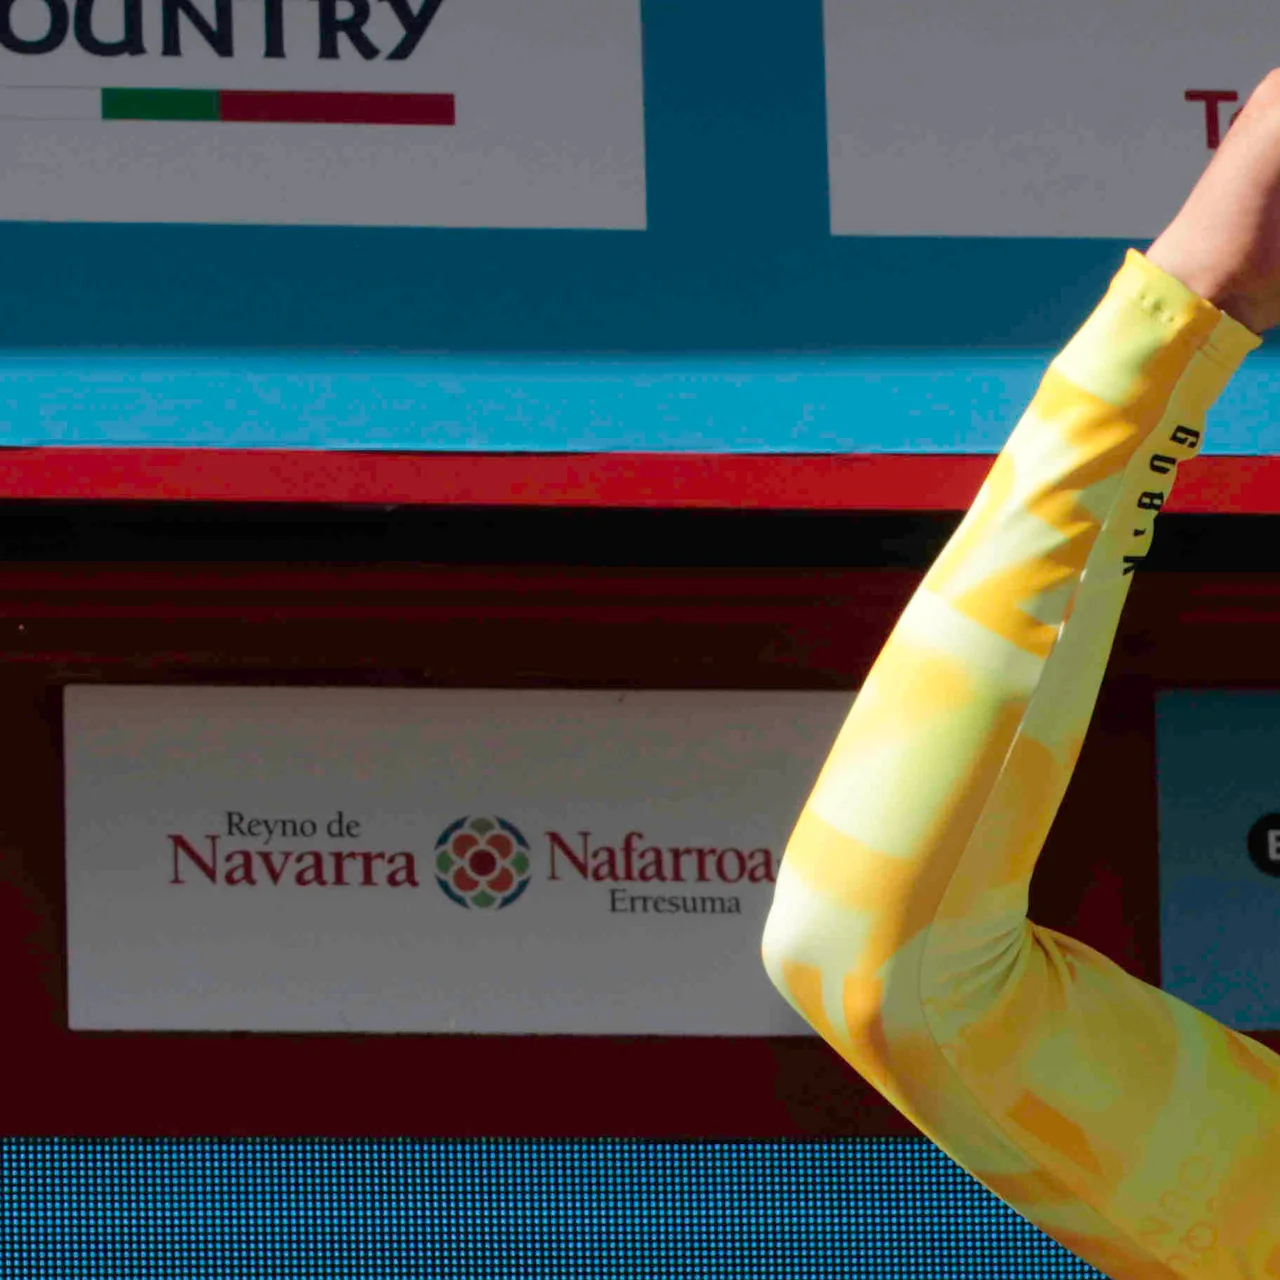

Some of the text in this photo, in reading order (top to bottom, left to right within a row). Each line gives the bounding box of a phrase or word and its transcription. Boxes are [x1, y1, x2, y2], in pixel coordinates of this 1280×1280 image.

[225, 811, 361, 846] Reyno de
[168, 830, 776, 888] Navarra Nafarroa
[608, 887, 742, 915] Erresuma
